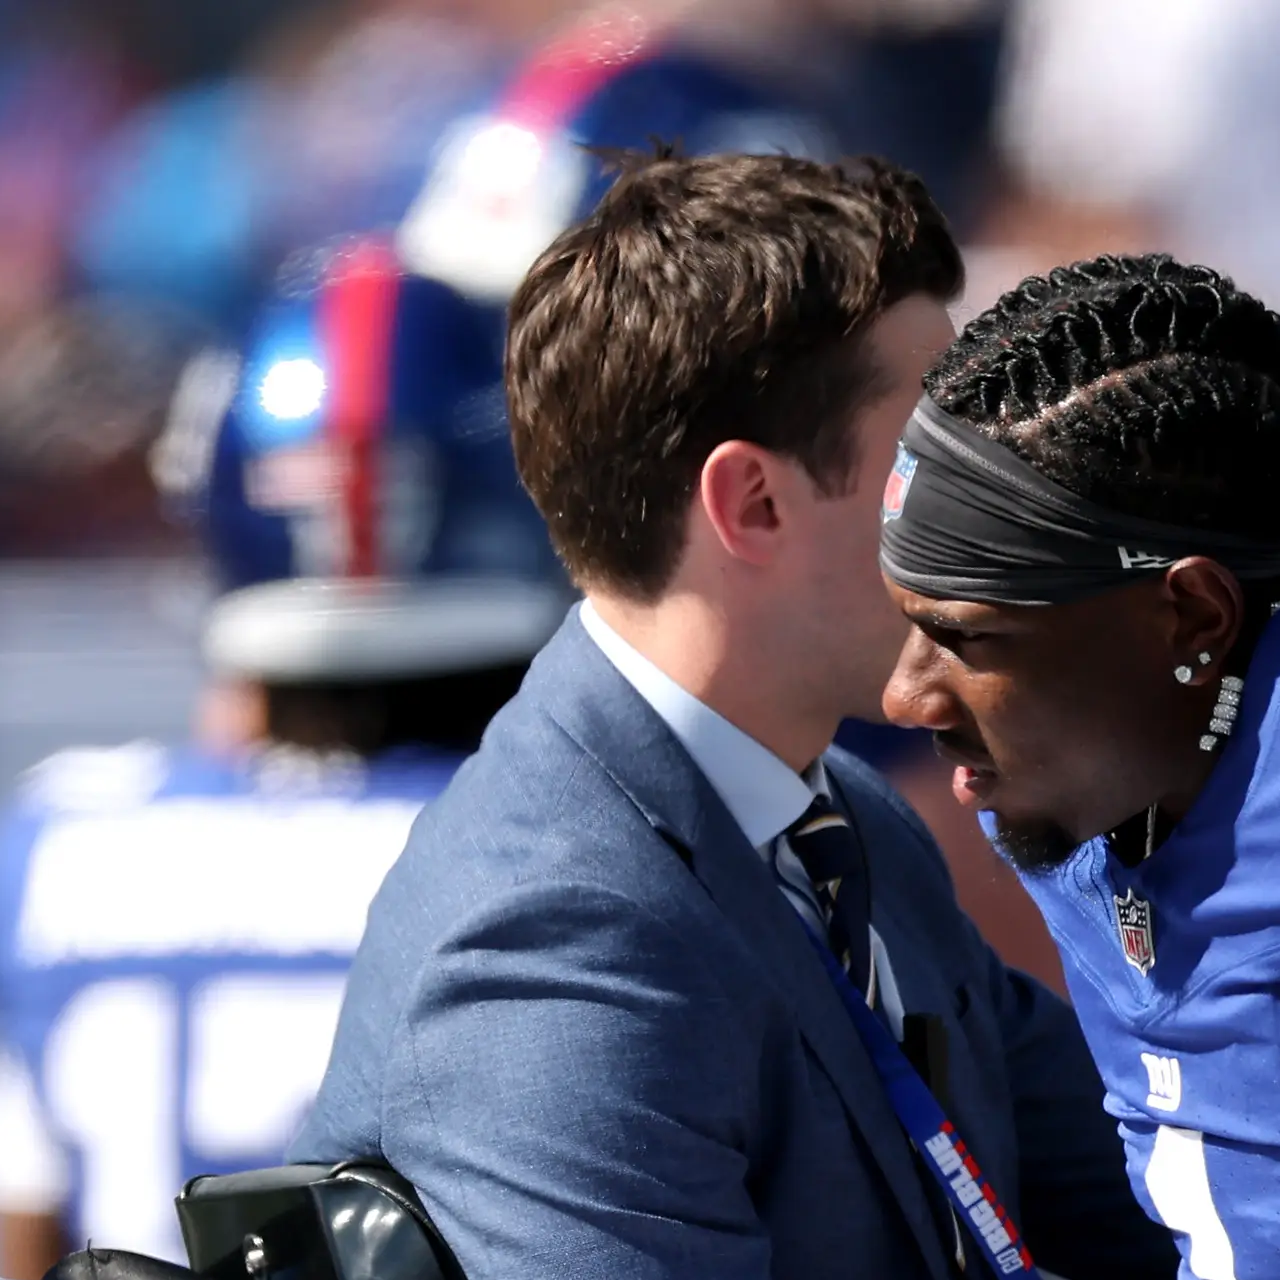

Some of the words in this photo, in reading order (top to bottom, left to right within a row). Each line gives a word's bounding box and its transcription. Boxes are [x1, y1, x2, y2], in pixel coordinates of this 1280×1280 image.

[1123, 928, 1151, 959] NFL
[923, 1130, 984, 1208] BLUE
[967, 1199, 1013, 1255] BIG
[995, 1246, 1025, 1275] GO
